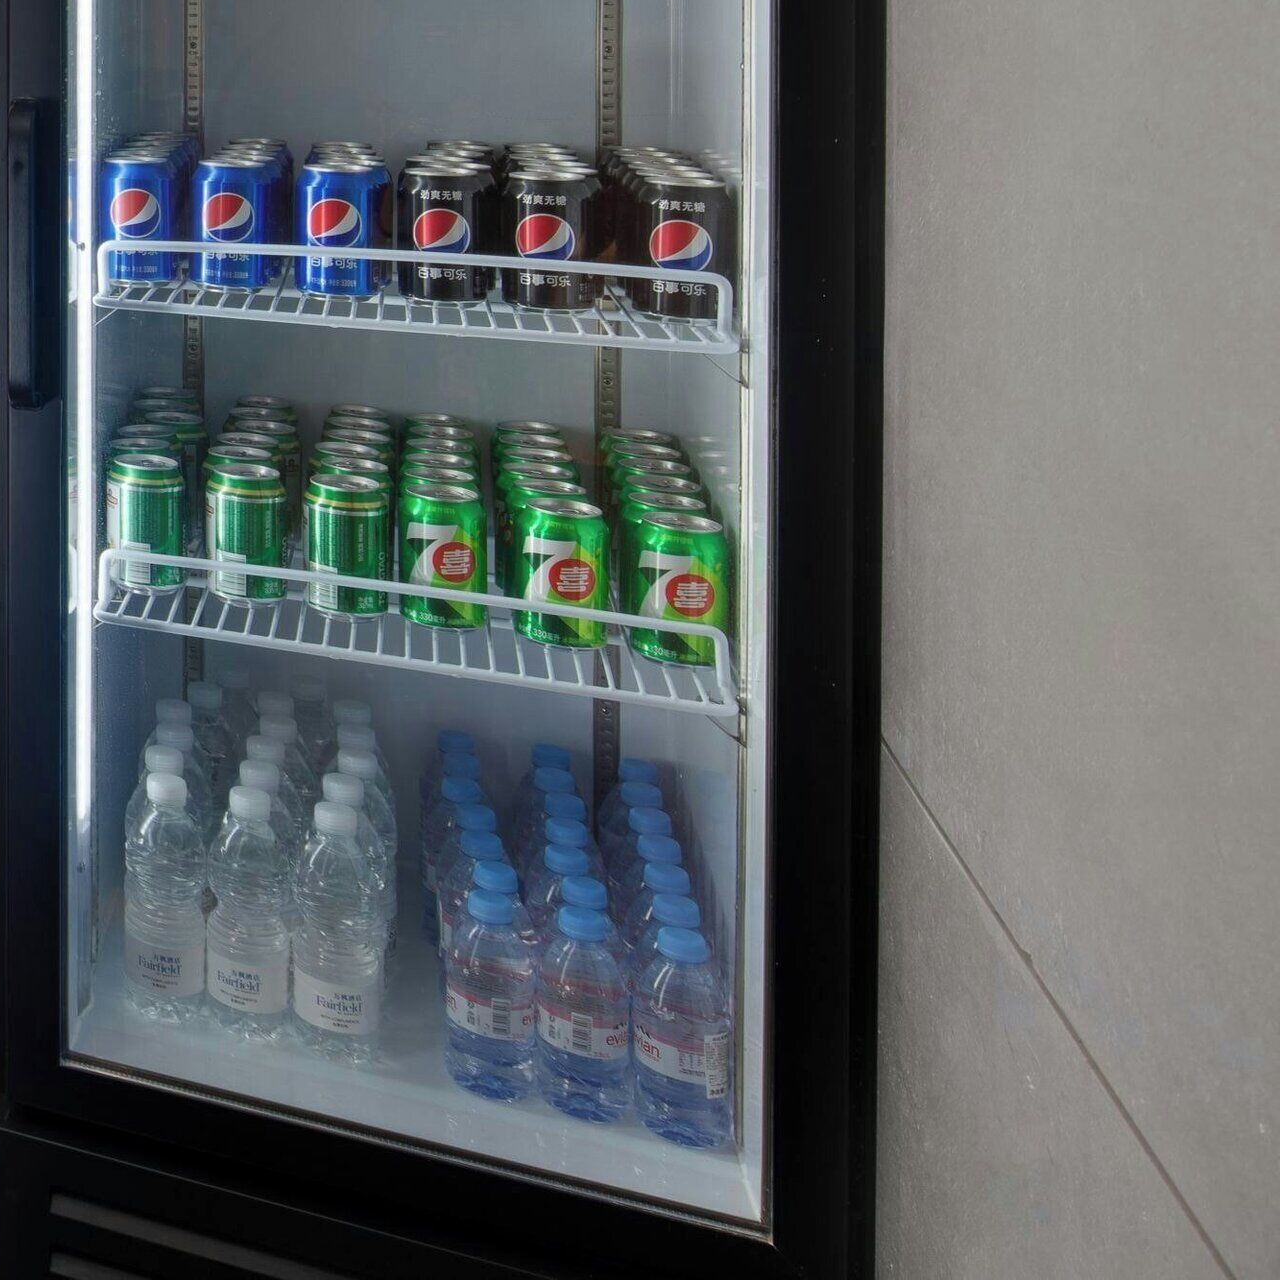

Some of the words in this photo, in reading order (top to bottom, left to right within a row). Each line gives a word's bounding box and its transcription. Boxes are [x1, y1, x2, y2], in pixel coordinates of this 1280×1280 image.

[420, 189, 463, 201] 劲爽无糖
[523, 194, 567, 206] 劲爽无糖
[659, 199, 706, 213] 劲爽无糖
[418, 267, 467, 281] 百事可乐
[520, 273, 572, 287] 百事可乐
[652, 280, 707, 296] 百事可乐
[138, 955, 182, 976] Fairfield
[217, 970, 261, 993] Fairfield
[315, 995, 363, 1013] Fairfield
